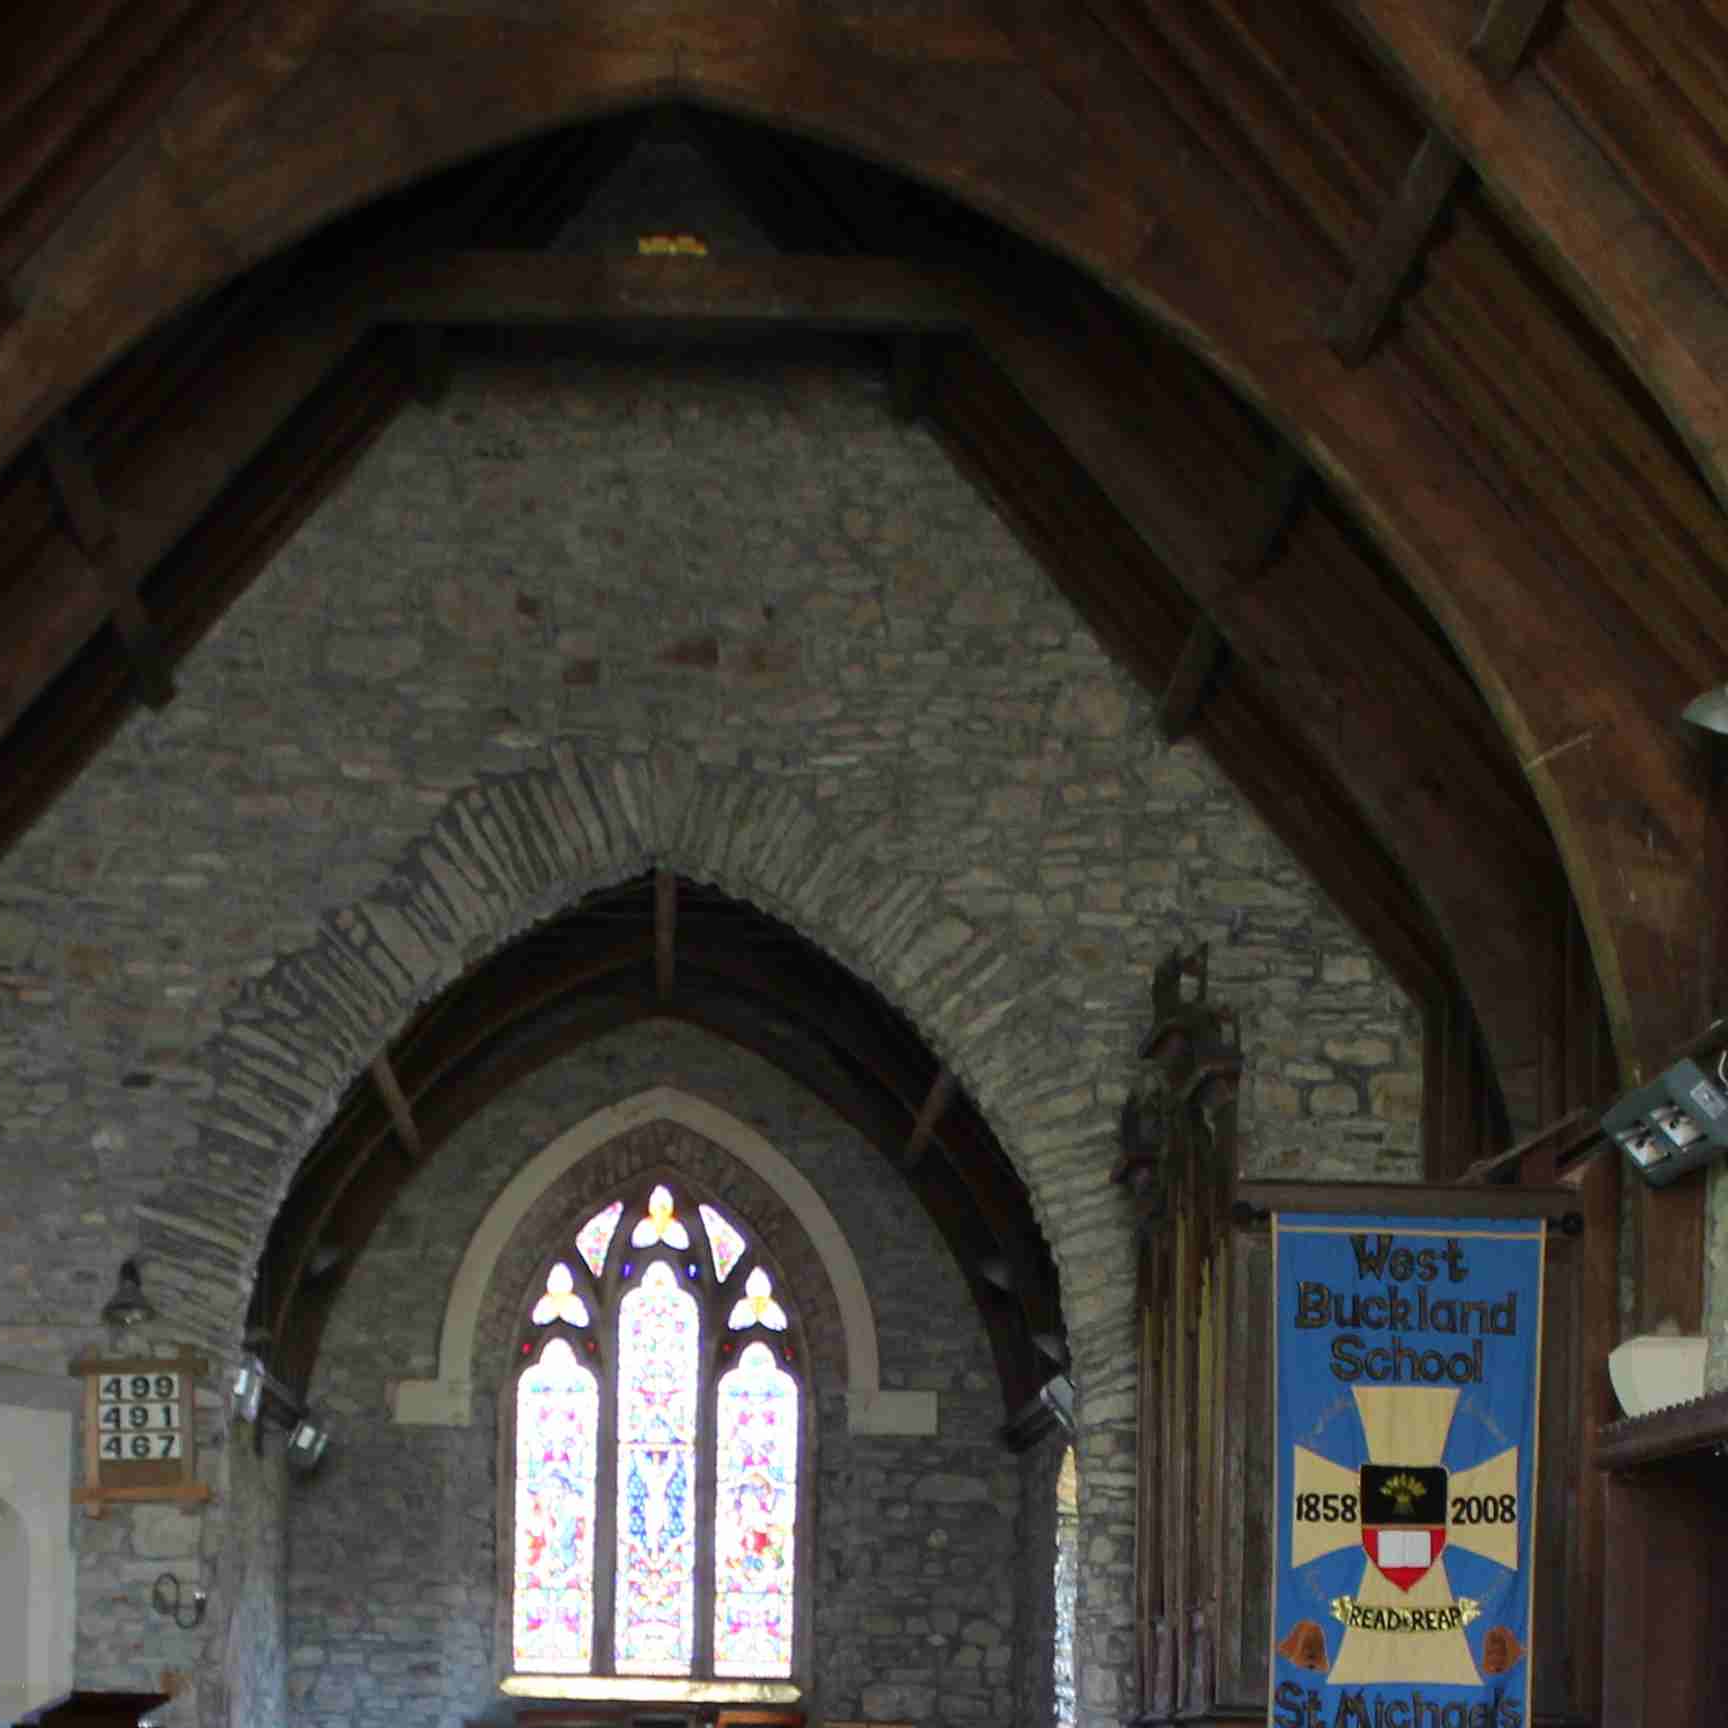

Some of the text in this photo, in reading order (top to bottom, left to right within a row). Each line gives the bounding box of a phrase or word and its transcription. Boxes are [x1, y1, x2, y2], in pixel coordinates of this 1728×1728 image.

[1349, 1233, 1469, 1282] West
[1295, 1280, 1517, 1336] Buckland
[1328, 1333, 1484, 1384] School
[103, 1376, 174, 1398] 499
[103, 1405, 172, 1429] 491
[103, 1434, 175, 1459] 467
[1296, 1493, 1516, 1525] 1858 2008
[1349, 1605, 1401, 1631] READ
[1410, 1606, 1462, 1632] REAP
